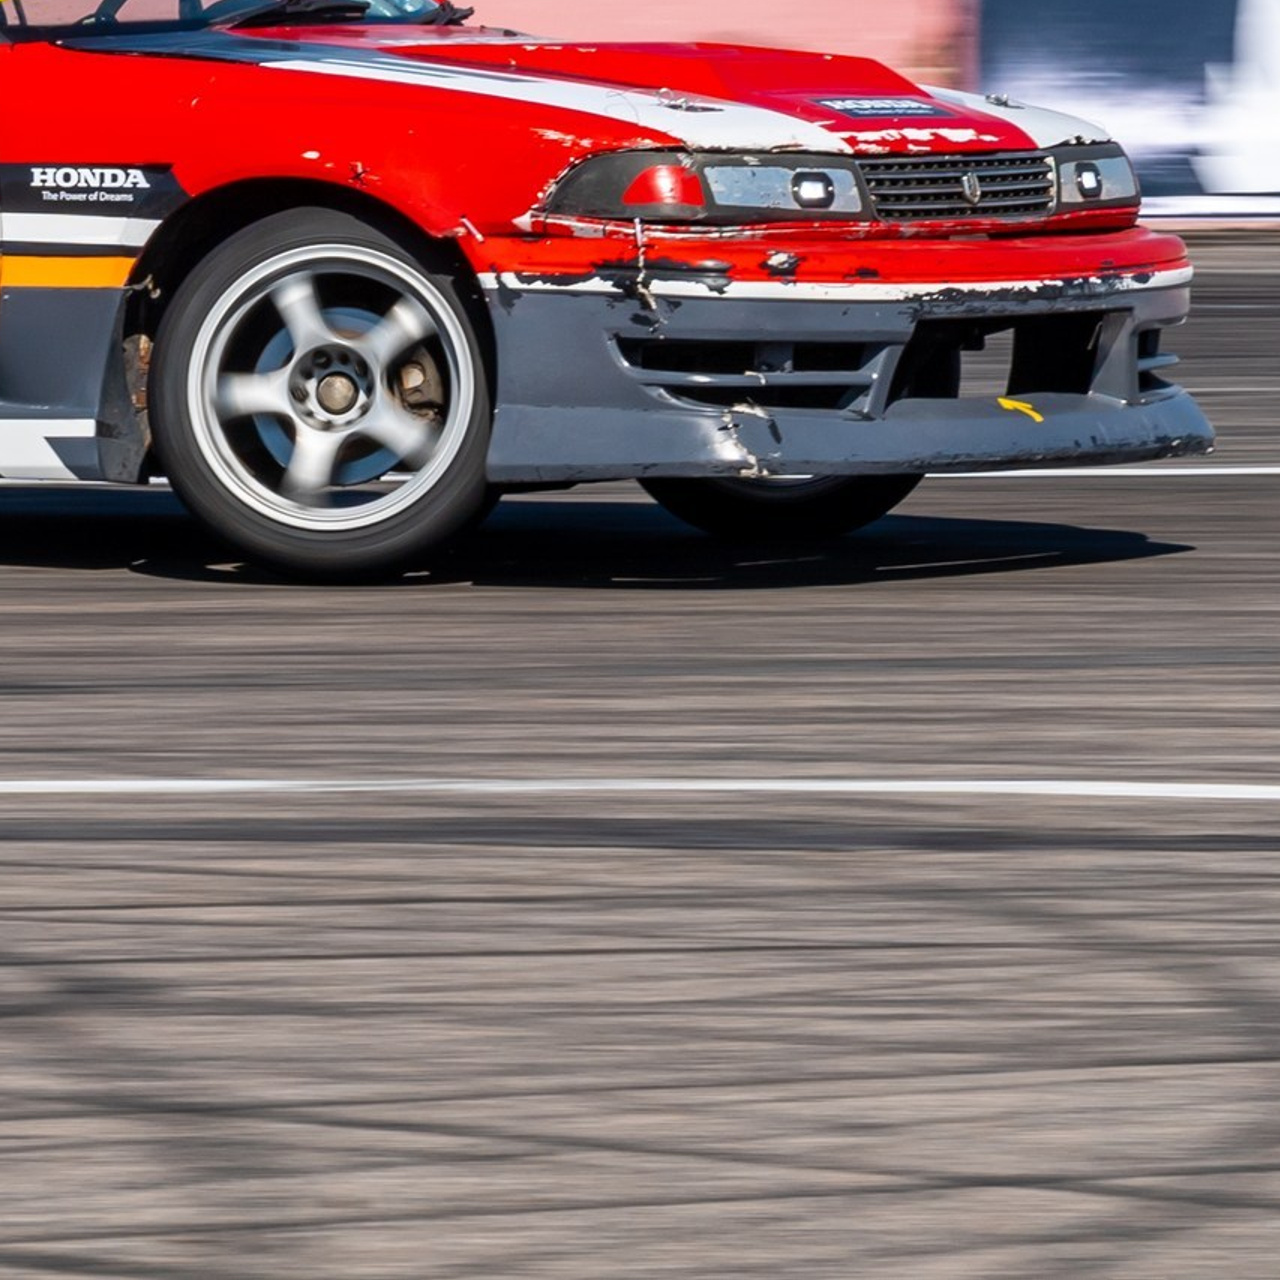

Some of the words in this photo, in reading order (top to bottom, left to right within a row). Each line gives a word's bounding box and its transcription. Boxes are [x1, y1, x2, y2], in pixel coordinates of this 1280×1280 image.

[30, 167, 151, 188] HONDA
[42, 191, 58, 201] The
[59, 192, 87, 201] Power
[88, 191, 98, 201] of
[99, 192, 134, 202] Dreams
